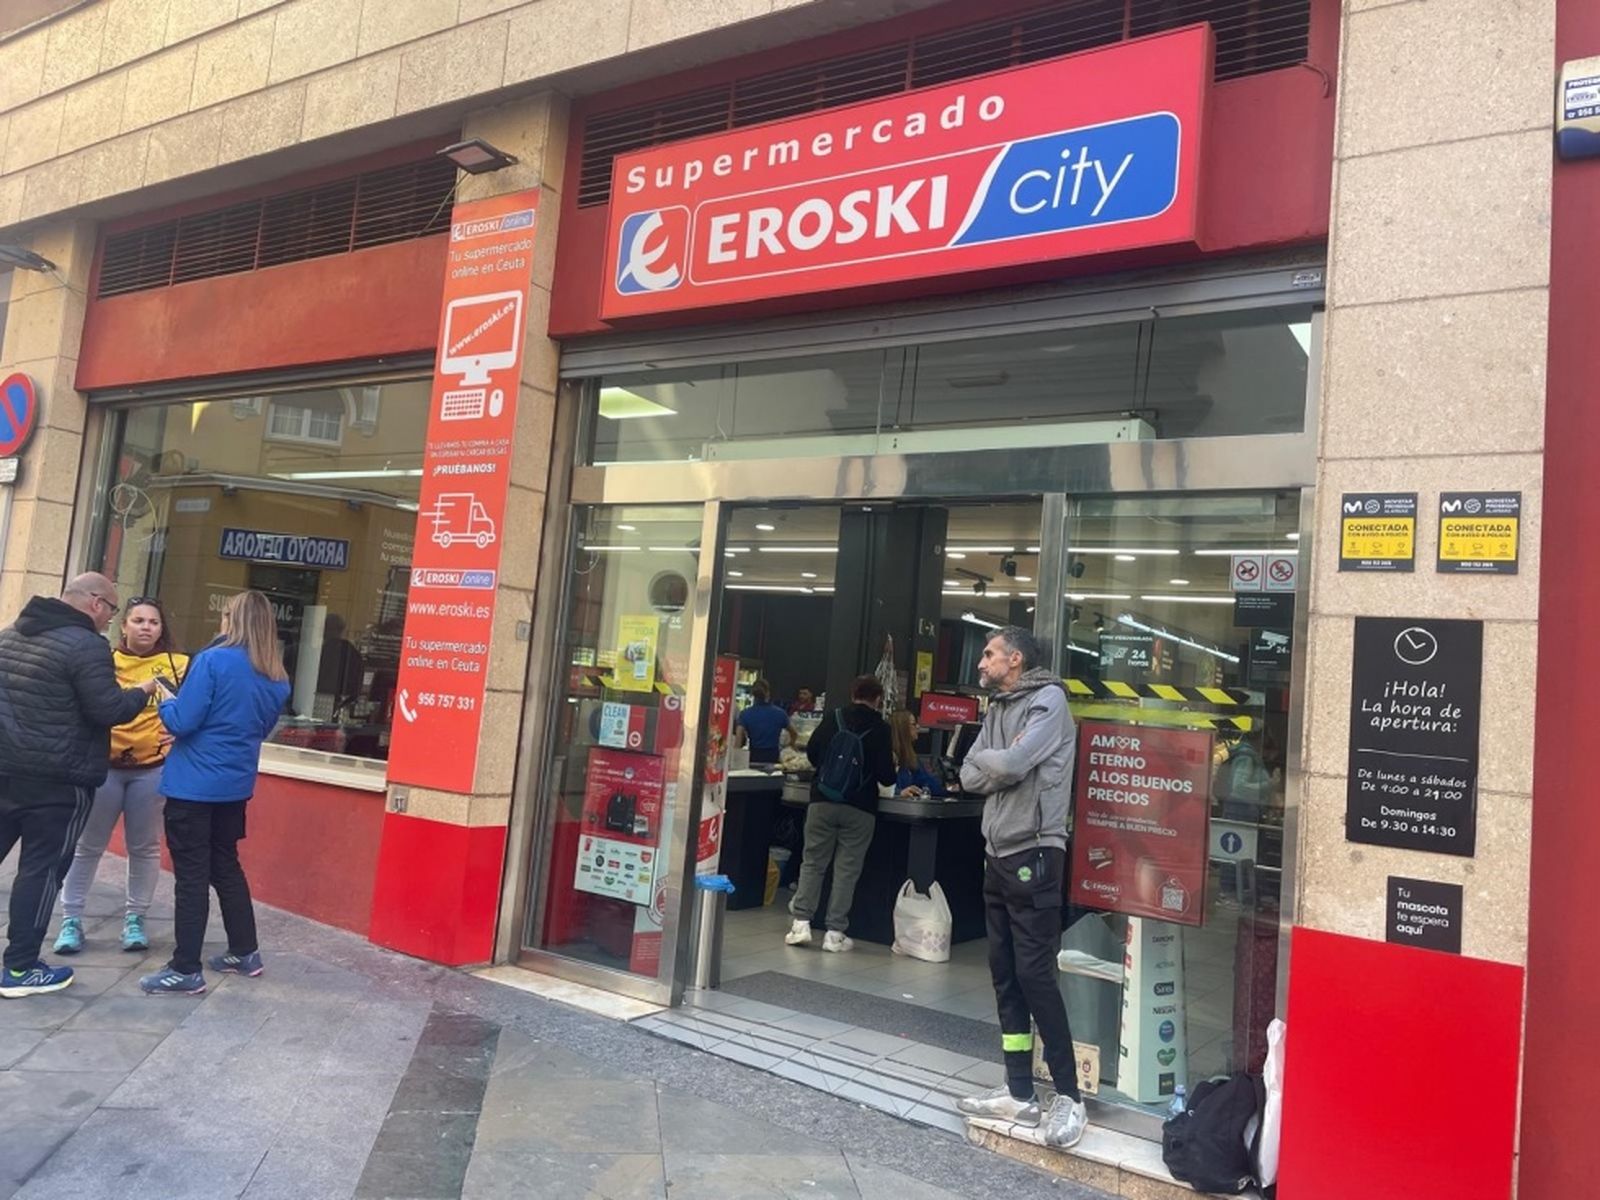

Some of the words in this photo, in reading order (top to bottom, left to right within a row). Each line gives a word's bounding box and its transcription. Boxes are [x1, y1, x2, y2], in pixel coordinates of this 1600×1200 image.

[625, 95, 1007, 193] Supermercado
[707, 174, 950, 267] EROSKI
[1009, 148, 1135, 216] city
[466, 220, 500, 236] EROSKI
[450, 250, 461, 262] Tu
[463, 239, 532, 261] supermercado
[451, 265, 480, 279] online
[481, 263, 494, 274] en
[496, 257, 525, 272] Ceuta
[449, 301, 515, 356] www.eroski.es
[433, 463, 496, 477] ¡PRUÉBANOS!
[1347, 524, 1409, 532] CONECTADA
[1446, 524, 1512, 532] CONECTADA
[426, 569, 460, 583] EROSKI
[464, 571, 490, 585] online
[409, 602, 490, 618] www.eroski.es
[406, 636, 417, 649] Tu
[419, 639, 487, 655] supermercado
[1131, 649, 1146, 659] 24
[407, 656, 434, 669] online
[436, 660, 448, 669] en
[451, 658, 480, 672] Ceuta
[1127, 659, 1149, 667] horas
[1384, 680, 1446, 698] ¡Hola!
[417, 692, 435, 706] 956
[438, 694, 455, 708] 757
[457, 695, 475, 710] 331
[1361, 699, 1382, 713] La
[1390, 699, 1431, 716] hora
[1439, 703, 1462, 718] de
[1370, 716, 1457, 732] apertura:
[1090, 752, 1146, 770] ETERNO
[1089, 770, 1099, 783] A
[1102, 771, 1129, 786] LOS
[1131, 774, 1193, 793] BUENOS
[1358, 768, 1372, 778] De
[1377, 770, 1406, 782] lunes
[1409, 775, 1417, 783] a
[1421, 775, 1467, 788] sábados
[1087, 787, 1150, 806] PRECIOS
[1361, 781, 1376, 791] De
[1412, 788, 1420, 796] a
[1380, 805, 1437, 821] Domingos
[1087, 818, 1118, 829] SIEMPRE
[1147, 826, 1178, 837] PRECIO
[1361, 817, 1377, 828] De
[1380, 820, 1408, 831] 9.30
[1411, 825, 1418, 833] a
[1422, 825, 1456, 837] 14:30
[1397, 887, 1411, 898] Tu
[1397, 901, 1448, 915] mascota
[1397, 911, 1408, 921] te
[1410, 915, 1449, 928] espera
[1396, 924, 1423, 936] aquí
